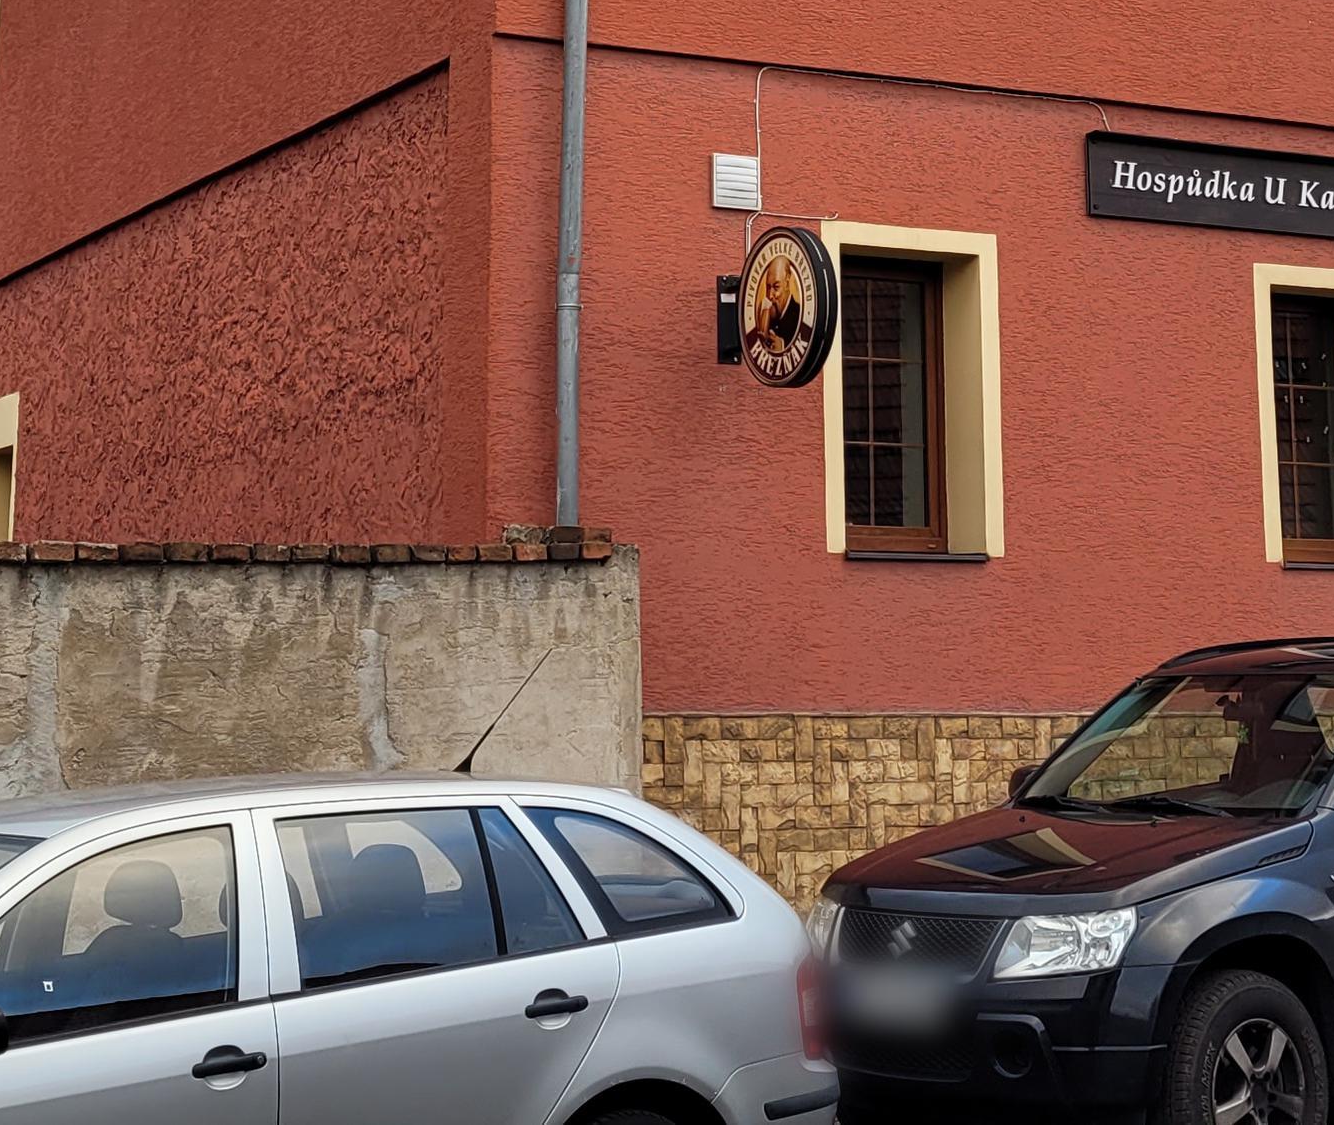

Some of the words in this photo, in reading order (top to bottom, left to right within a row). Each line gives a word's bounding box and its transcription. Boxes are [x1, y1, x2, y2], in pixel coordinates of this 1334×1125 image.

[1111, 160, 1255, 203] Hospůdka
[1264, 176, 1287, 205] U
[747, 252, 767, 307] PIVOVAR
